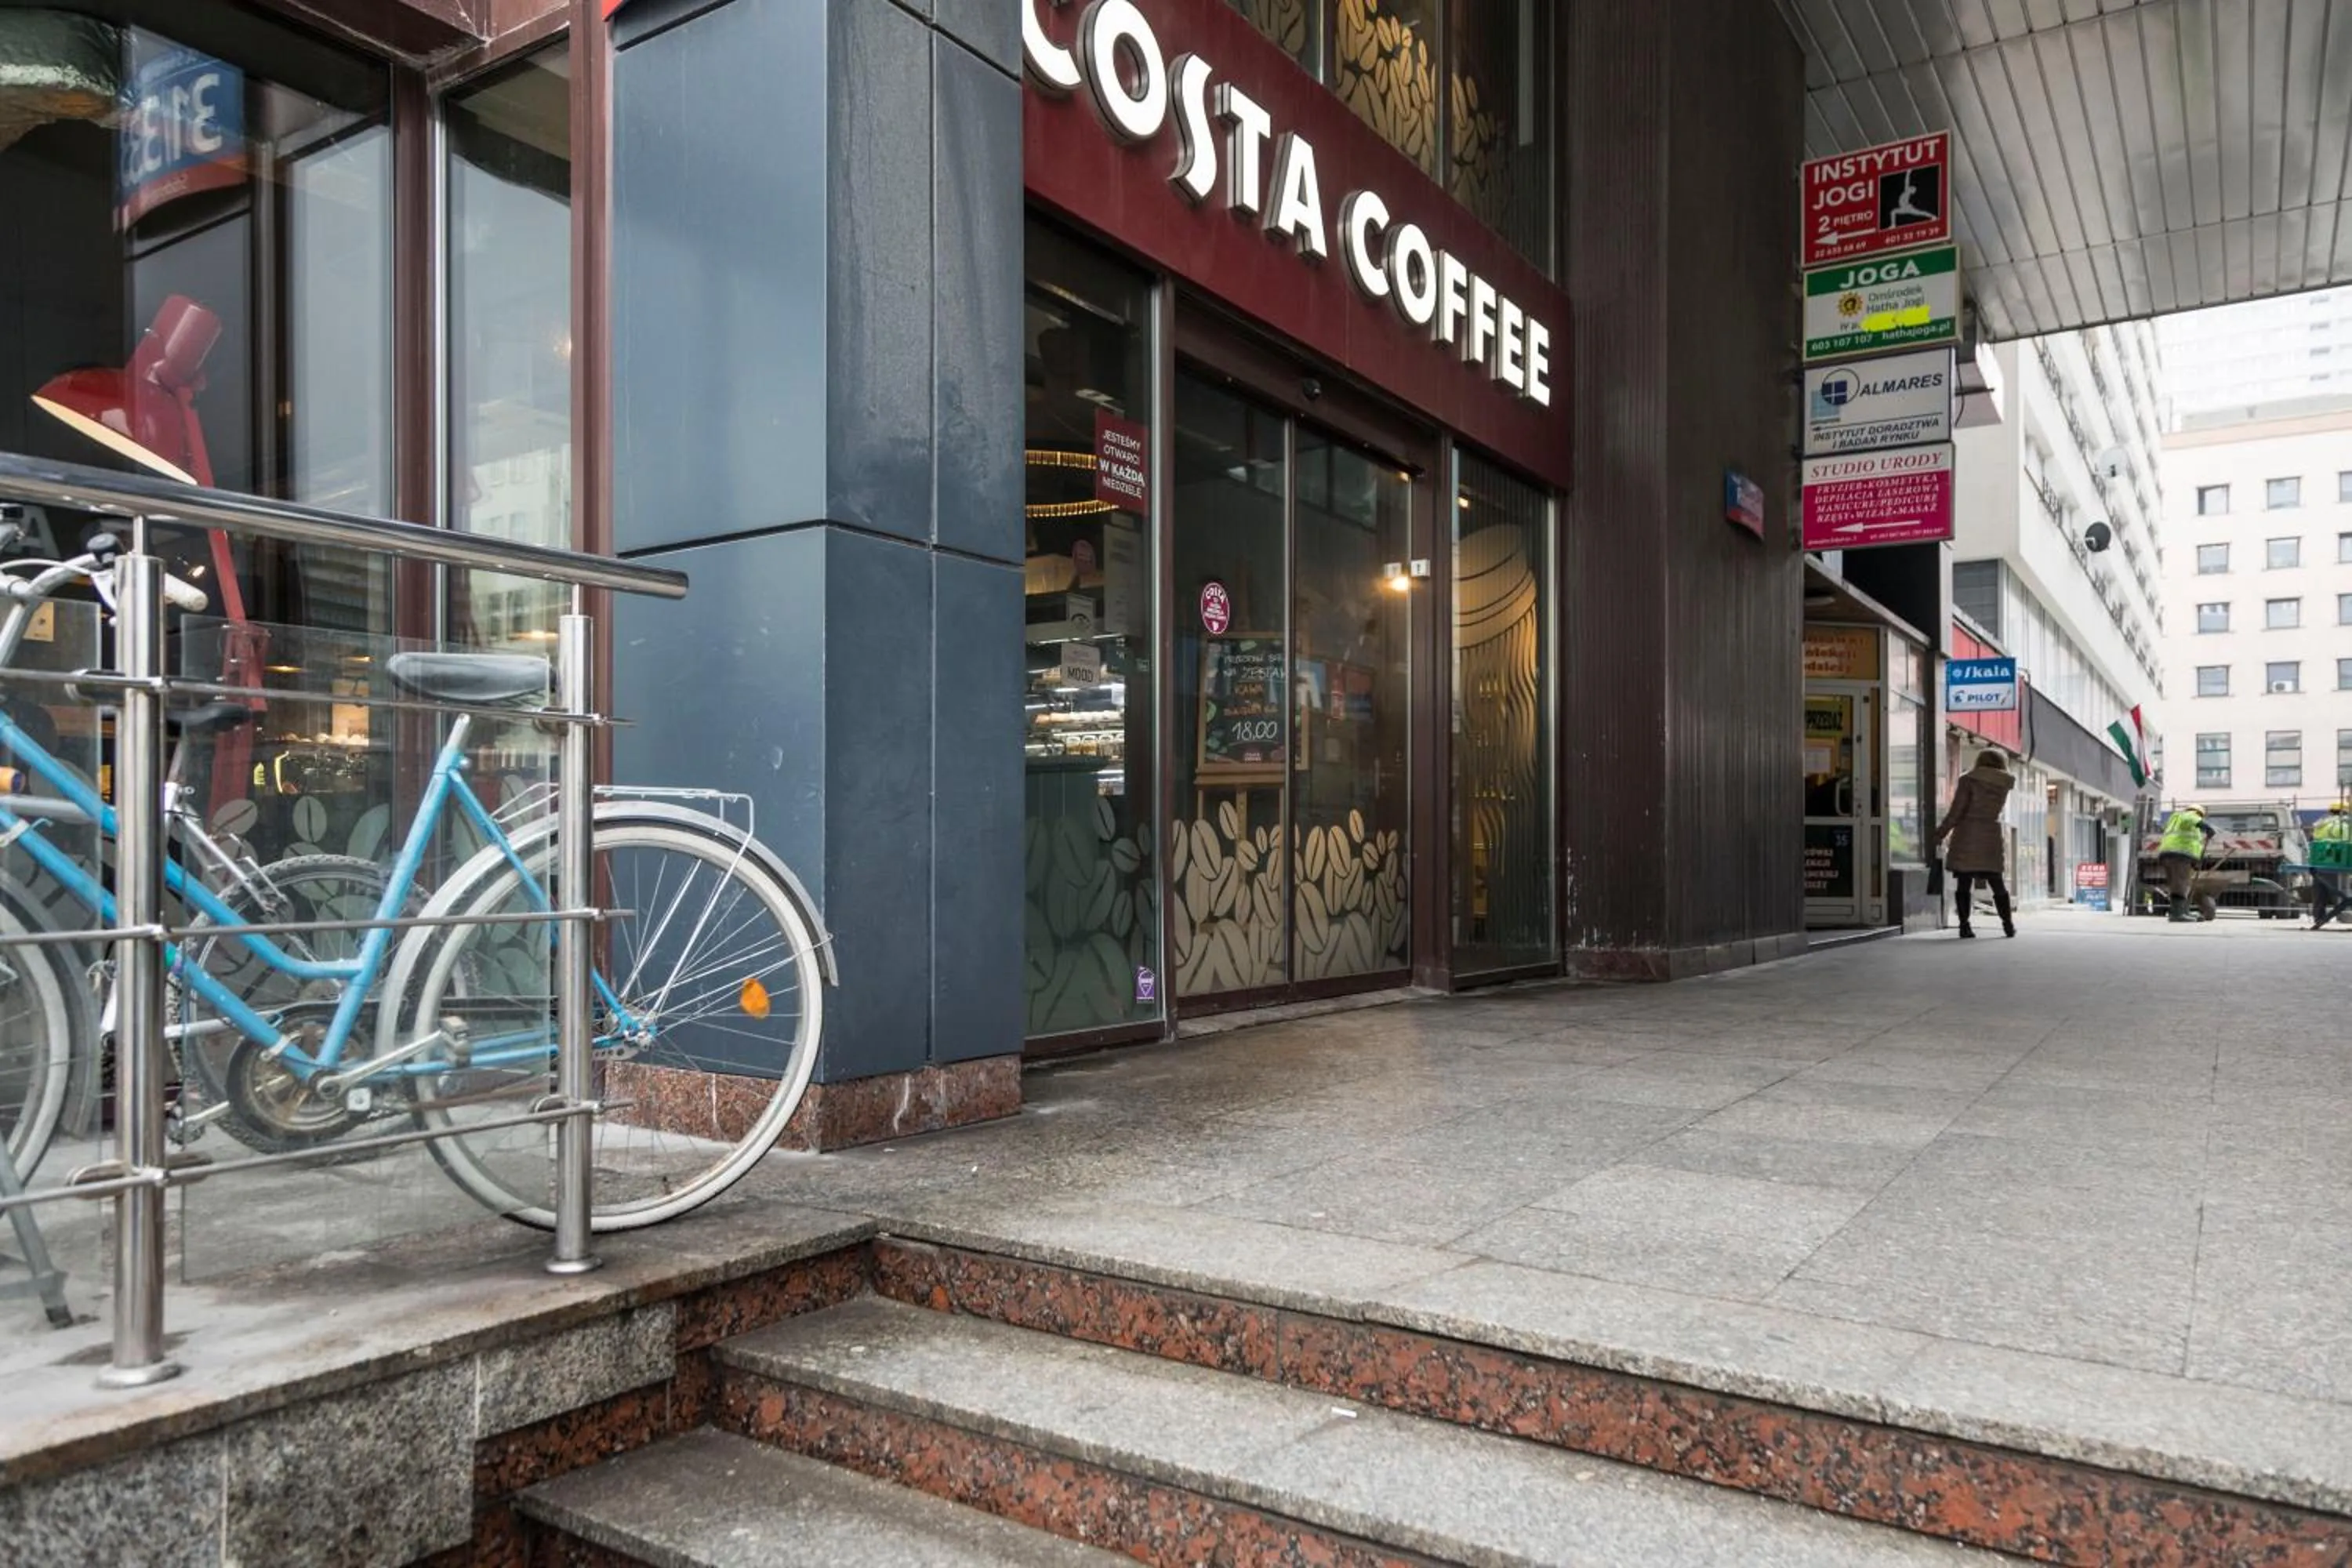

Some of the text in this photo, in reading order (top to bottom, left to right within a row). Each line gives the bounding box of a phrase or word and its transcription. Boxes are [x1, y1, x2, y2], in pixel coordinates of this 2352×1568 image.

[1813, 138, 1940, 184] INSTYTUT
[1812, 180, 1874, 211] JOGI
[1818, 216, 1830, 233] 2
[1838, 260, 1920, 289] JOGA
[1341, 191, 1550, 407] COFFEE
[1866, 300, 1899, 314] Hatha
[1859, 373, 1944, 397] ALMARES
[1813, 418, 1940, 441] INSTYTUT DORADZTWA
[1880, 430, 1920, 444] RYNKU
[1099, 458, 1109, 472] W
[1810, 452, 1943, 478] STUDIO URODY
[1967, 693, 2000, 702] PILOT
